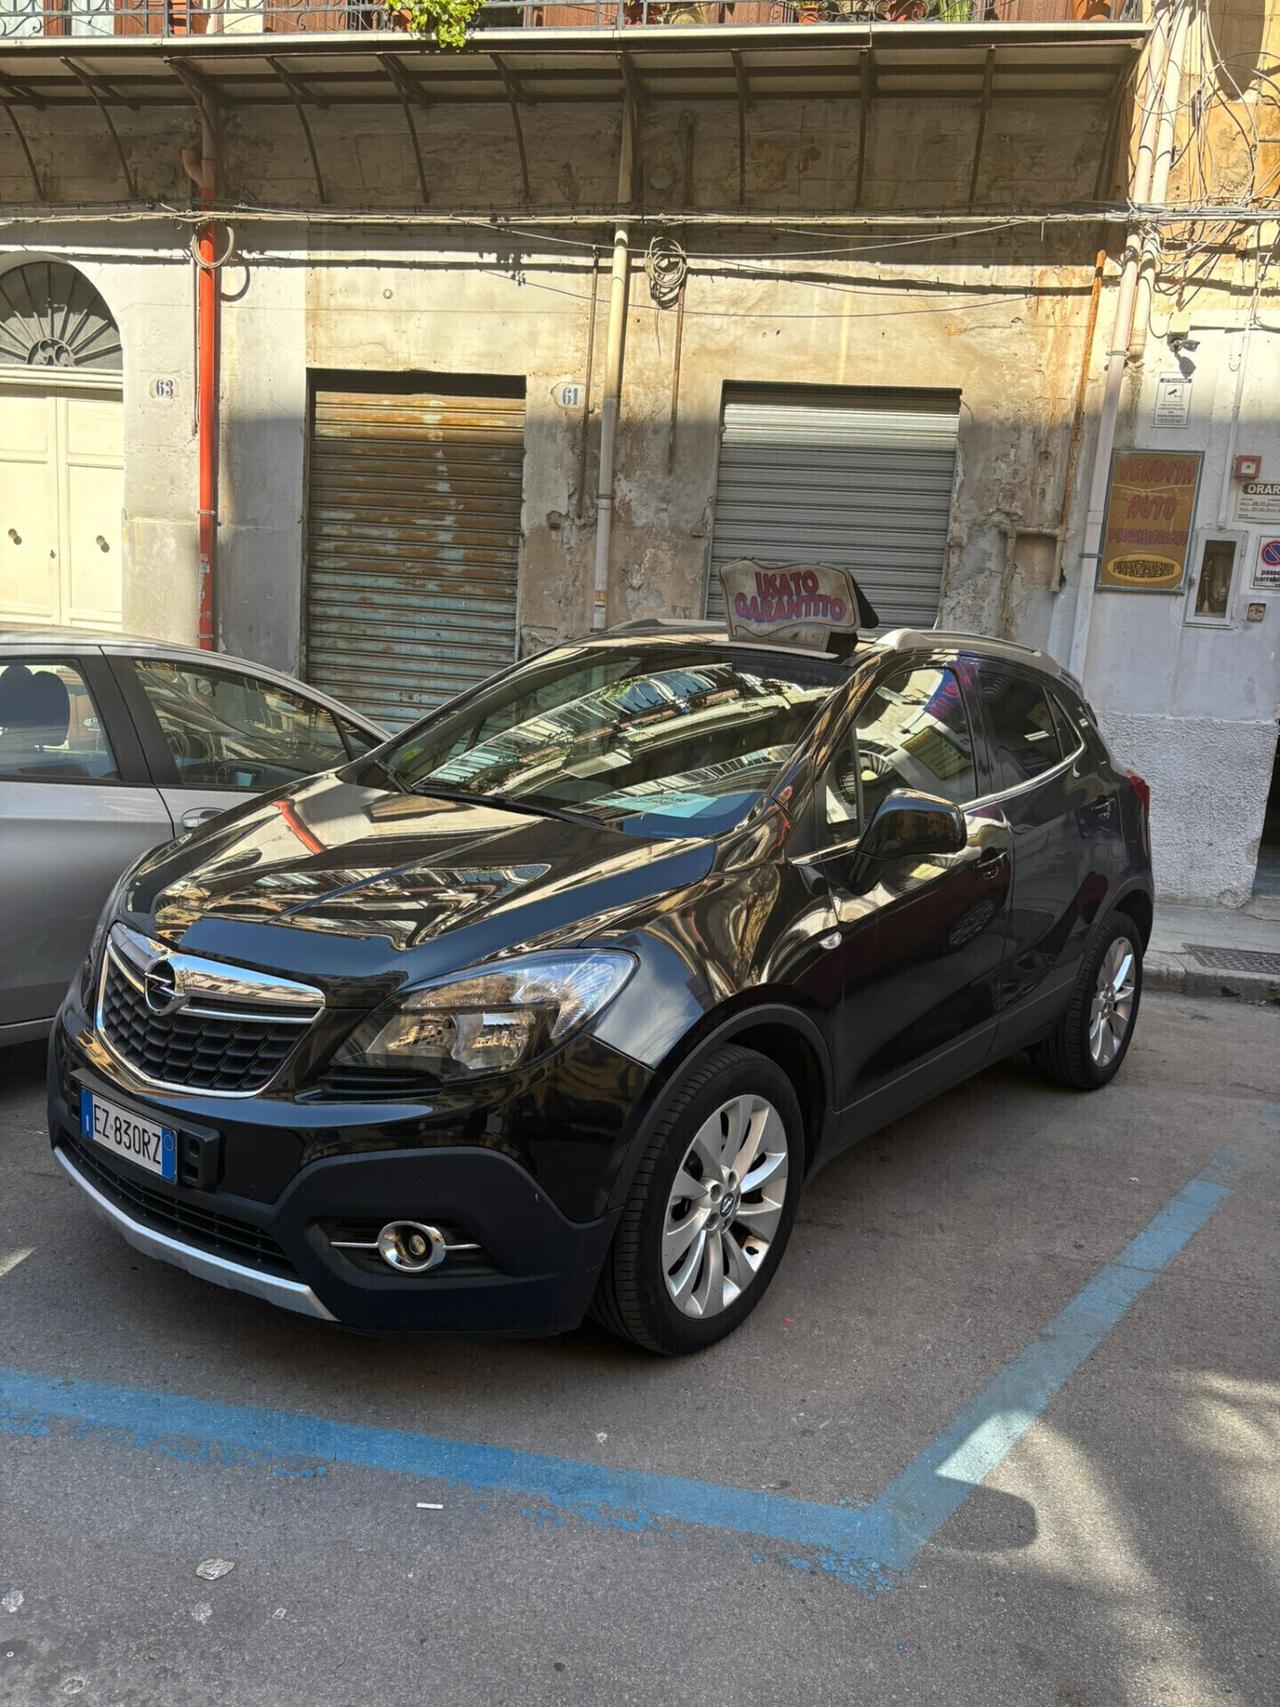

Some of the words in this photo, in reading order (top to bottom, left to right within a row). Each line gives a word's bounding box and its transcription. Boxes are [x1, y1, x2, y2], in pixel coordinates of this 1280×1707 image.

[156, 379, 173, 398] 63
[562, 387, 578, 405] 61
[1118, 458, 1197, 485] VENDITA
[1126, 495, 1177, 520] AUTO
[755, 569, 819, 599] USATO
[735, 592, 847, 622] GARANTITO
[94, 1104, 110, 1140] EZ
[114, 1115, 162, 1165] 830RZ
